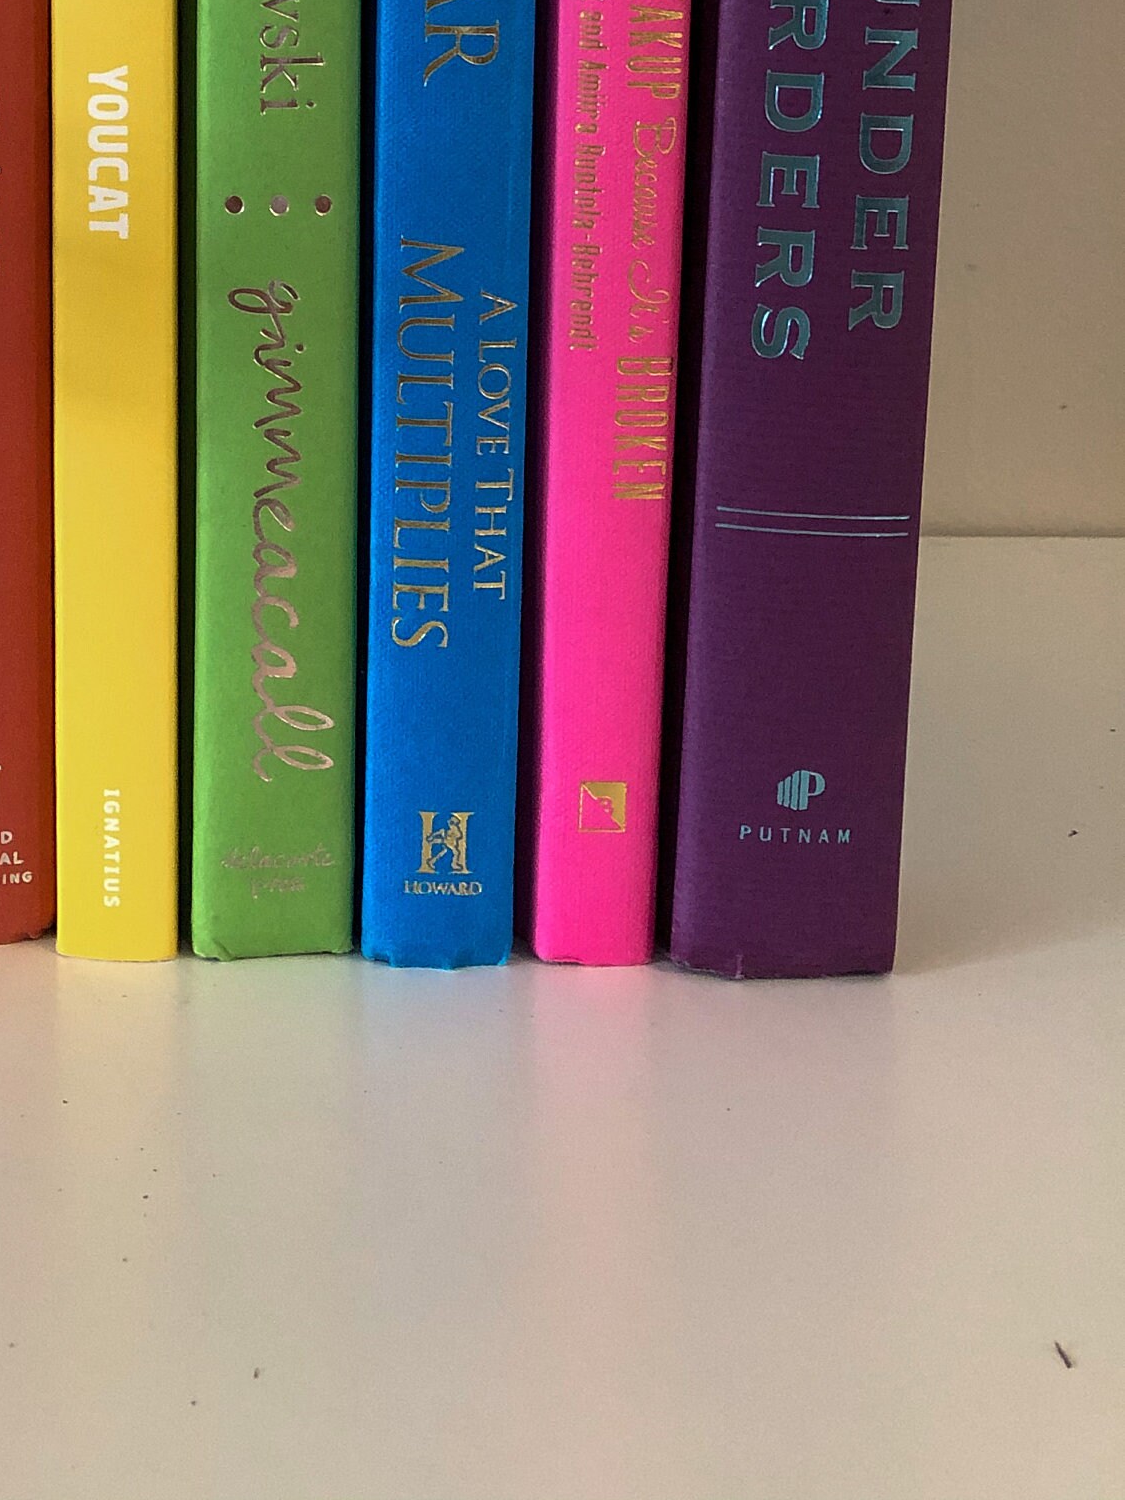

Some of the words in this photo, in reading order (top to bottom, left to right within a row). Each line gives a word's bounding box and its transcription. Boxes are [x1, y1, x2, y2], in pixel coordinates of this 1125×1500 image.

[578, 11, 610, 51] and
[87, 64, 131, 241] YOUCAT
[479, 290, 520, 324] A
[390, 236, 468, 650] MULTIPLIES
[475, 335, 518, 456] LOVE
[612, 356, 674, 501] BROKEN
[472, 469, 514, 602] THAT
[101, 788, 121, 908] IGNATIUS
[402, 879, 483, 897] HOWARD
[739, 825, 853, 845] PUTNAM
